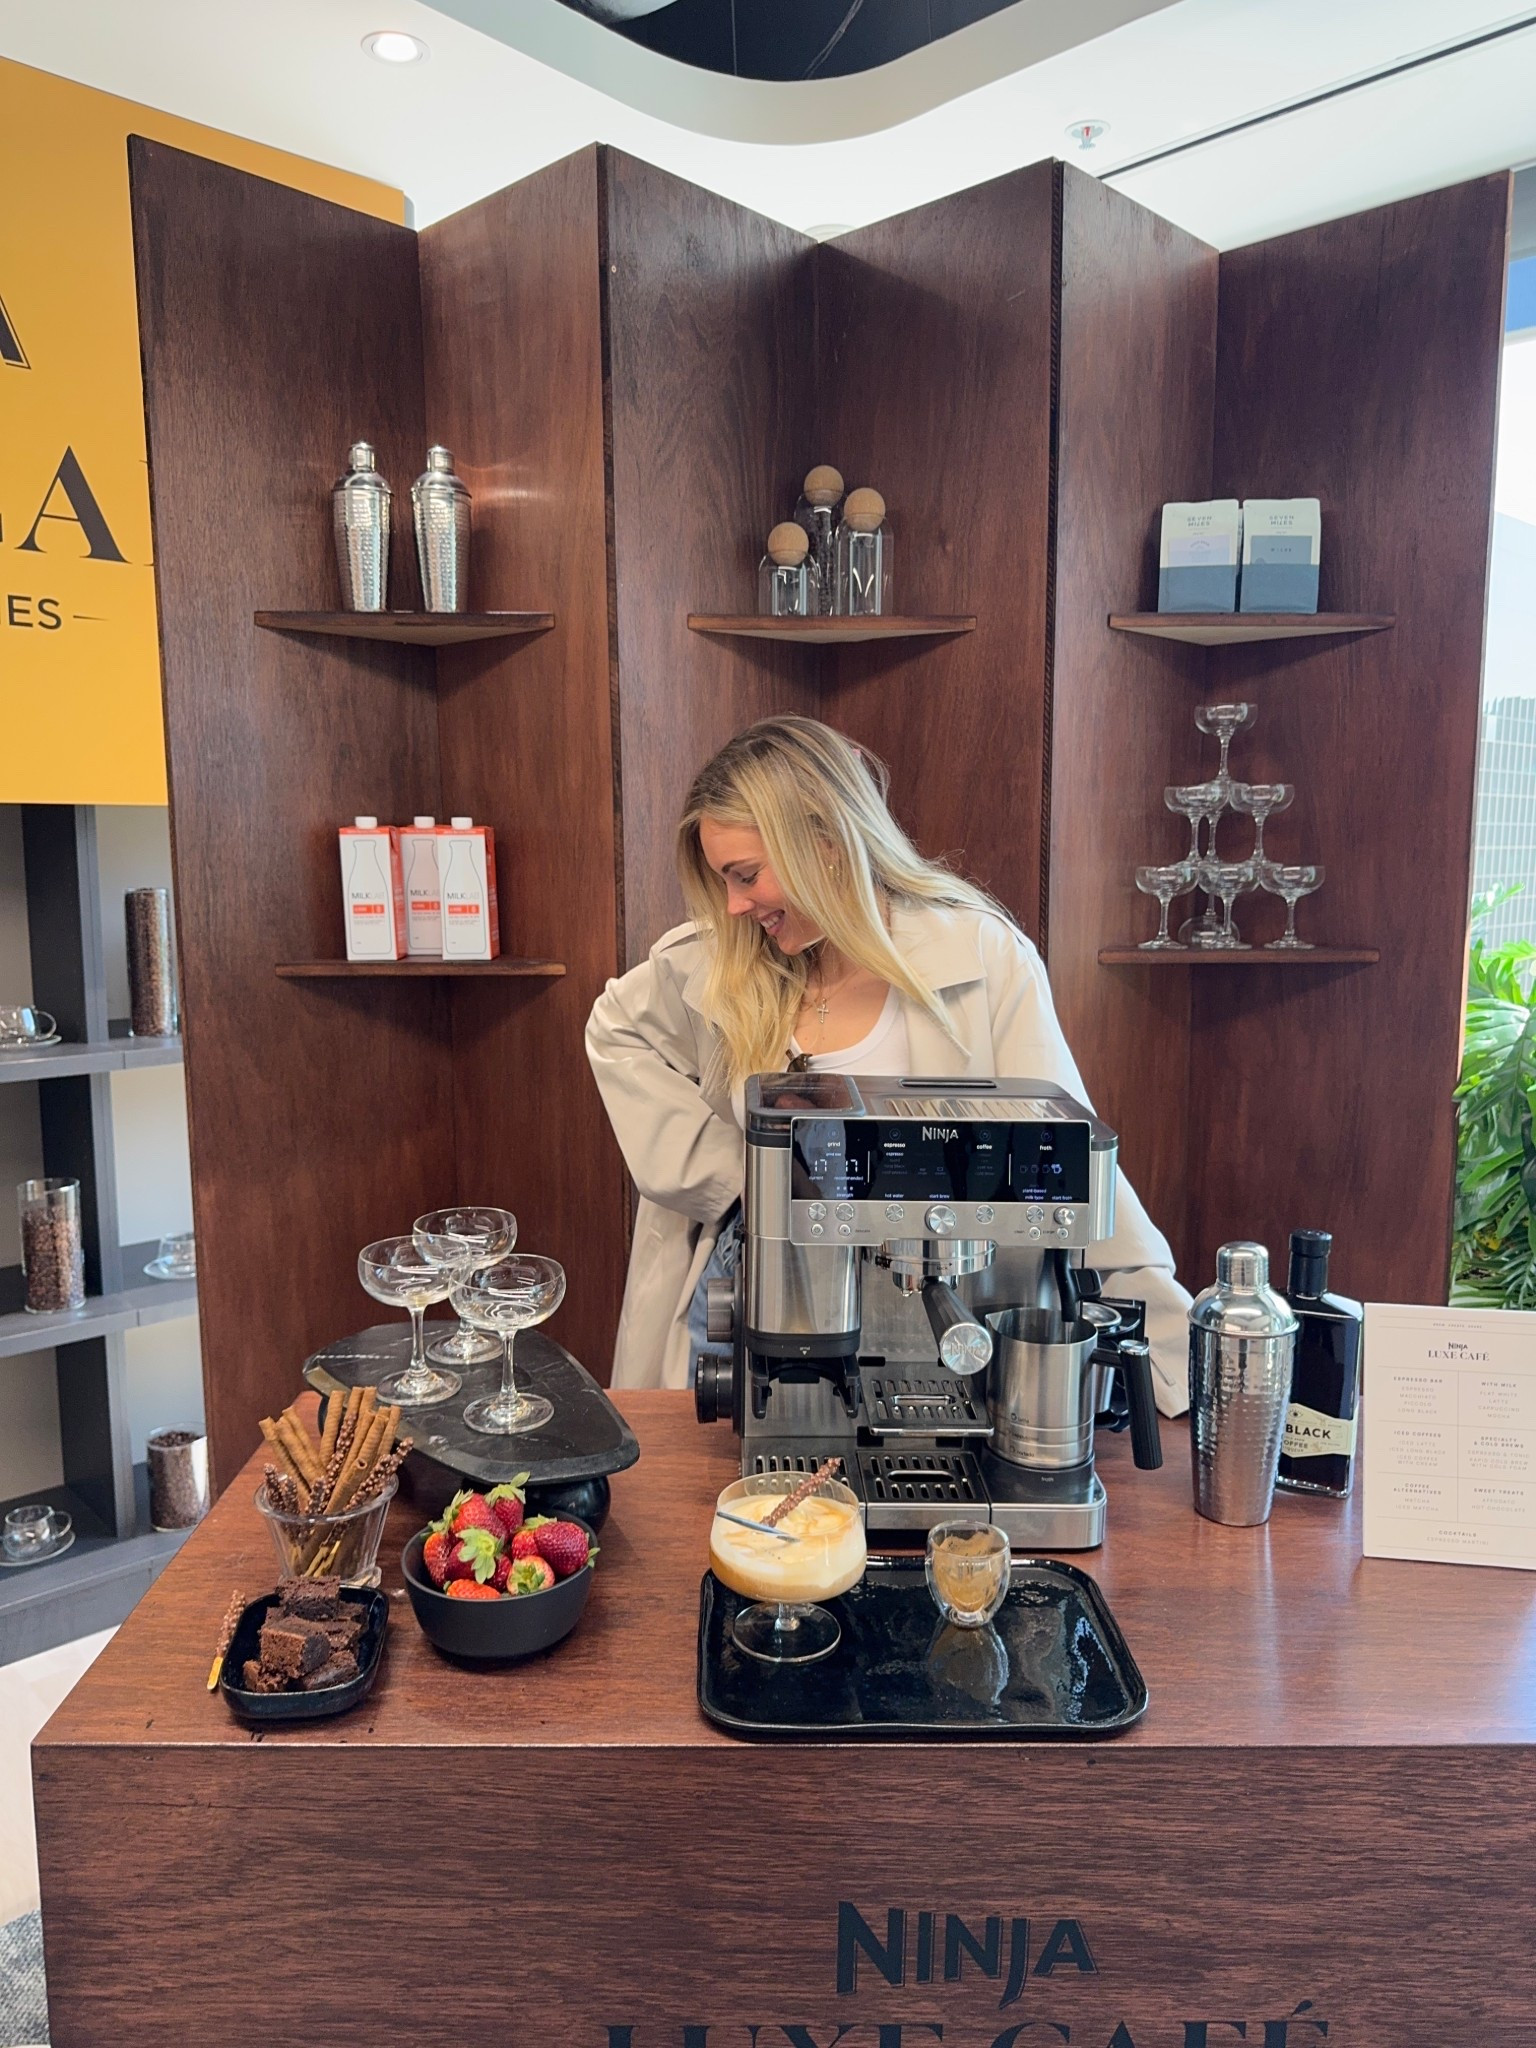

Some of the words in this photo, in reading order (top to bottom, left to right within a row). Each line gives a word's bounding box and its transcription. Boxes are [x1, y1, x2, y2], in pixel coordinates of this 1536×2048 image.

[0, 594, 62, 630] ES
[922, 1126, 959, 1144] NINJA
[1448, 1342, 1468, 1351] NINJA
[1428, 1350, 1458, 1359] LUXE
[1459, 1351, 1490, 1361] CAFÉ
[1285, 1424, 1331, 1439] BLACK
[1283, 1439, 1308, 1449] OFFEE
[836, 1900, 1097, 2009] NINJA
